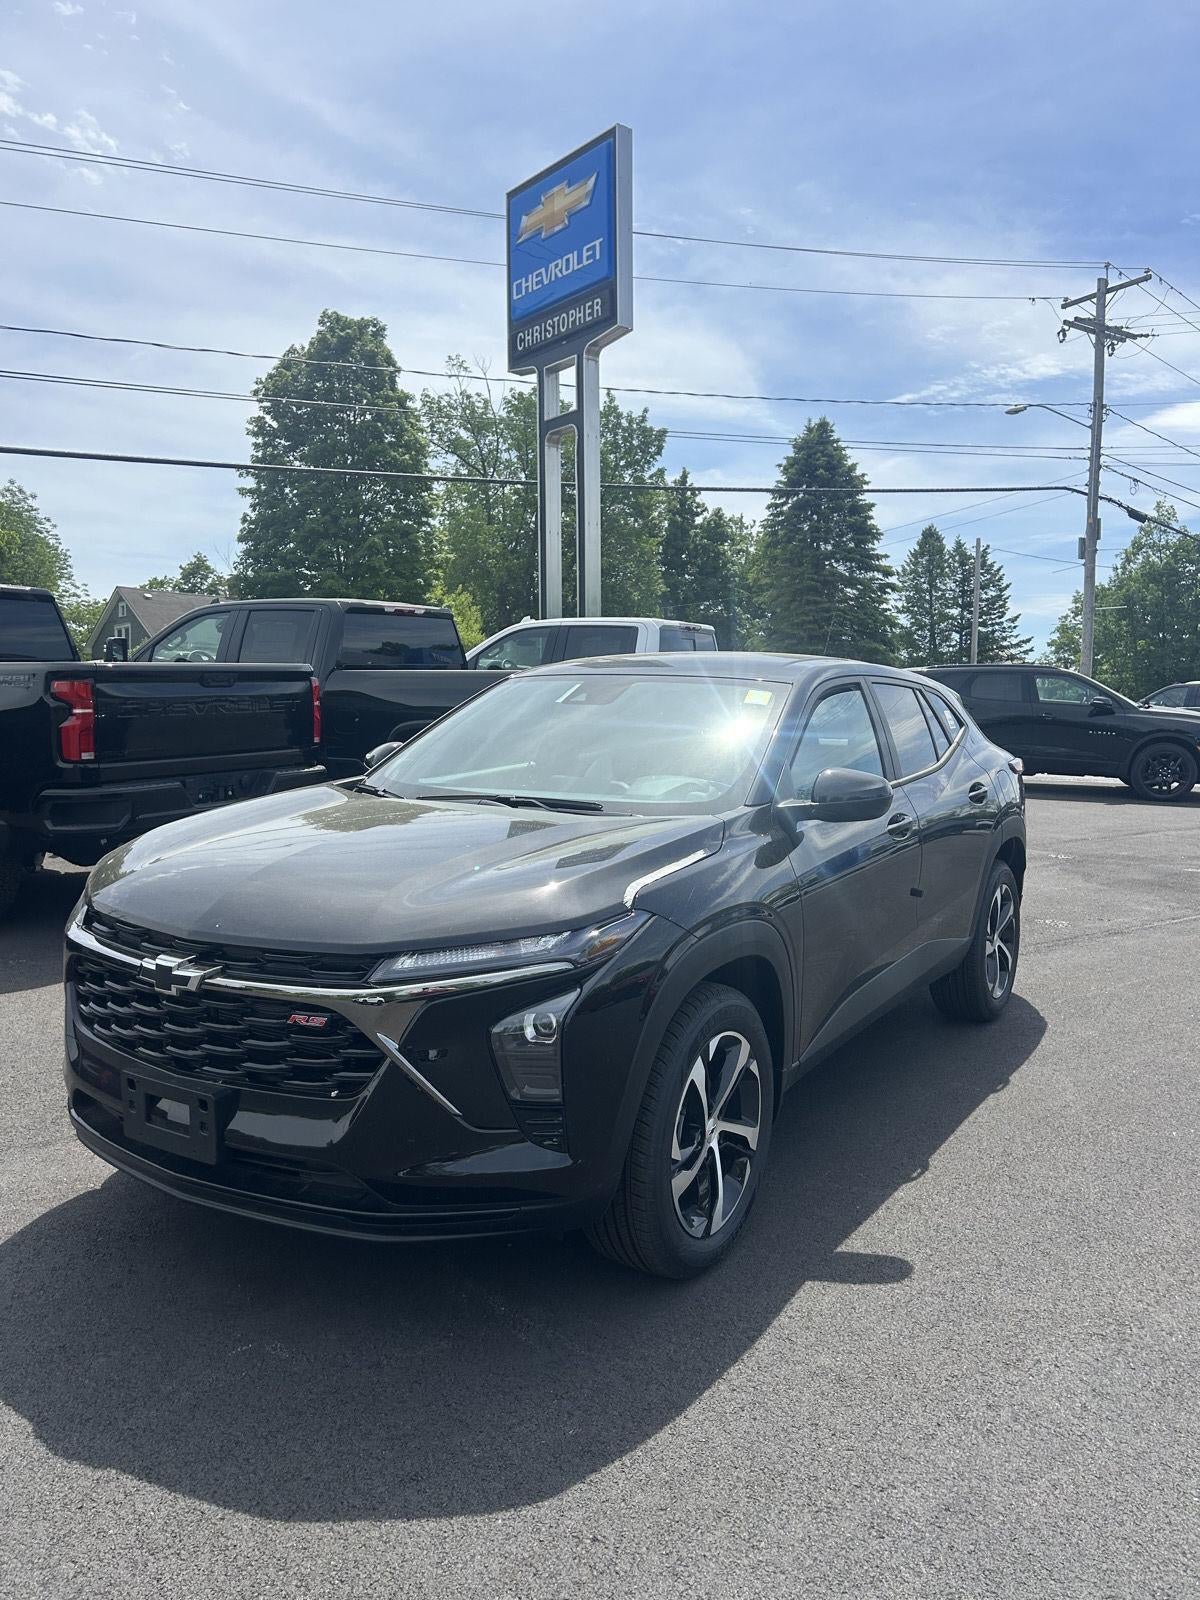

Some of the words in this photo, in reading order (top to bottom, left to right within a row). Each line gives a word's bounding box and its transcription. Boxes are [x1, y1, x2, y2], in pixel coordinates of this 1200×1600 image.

[512, 238, 604, 300] CHEVROLET
[516, 298, 602, 351] CHRISTOPHER
[287, 1014, 328, 1027] RS
